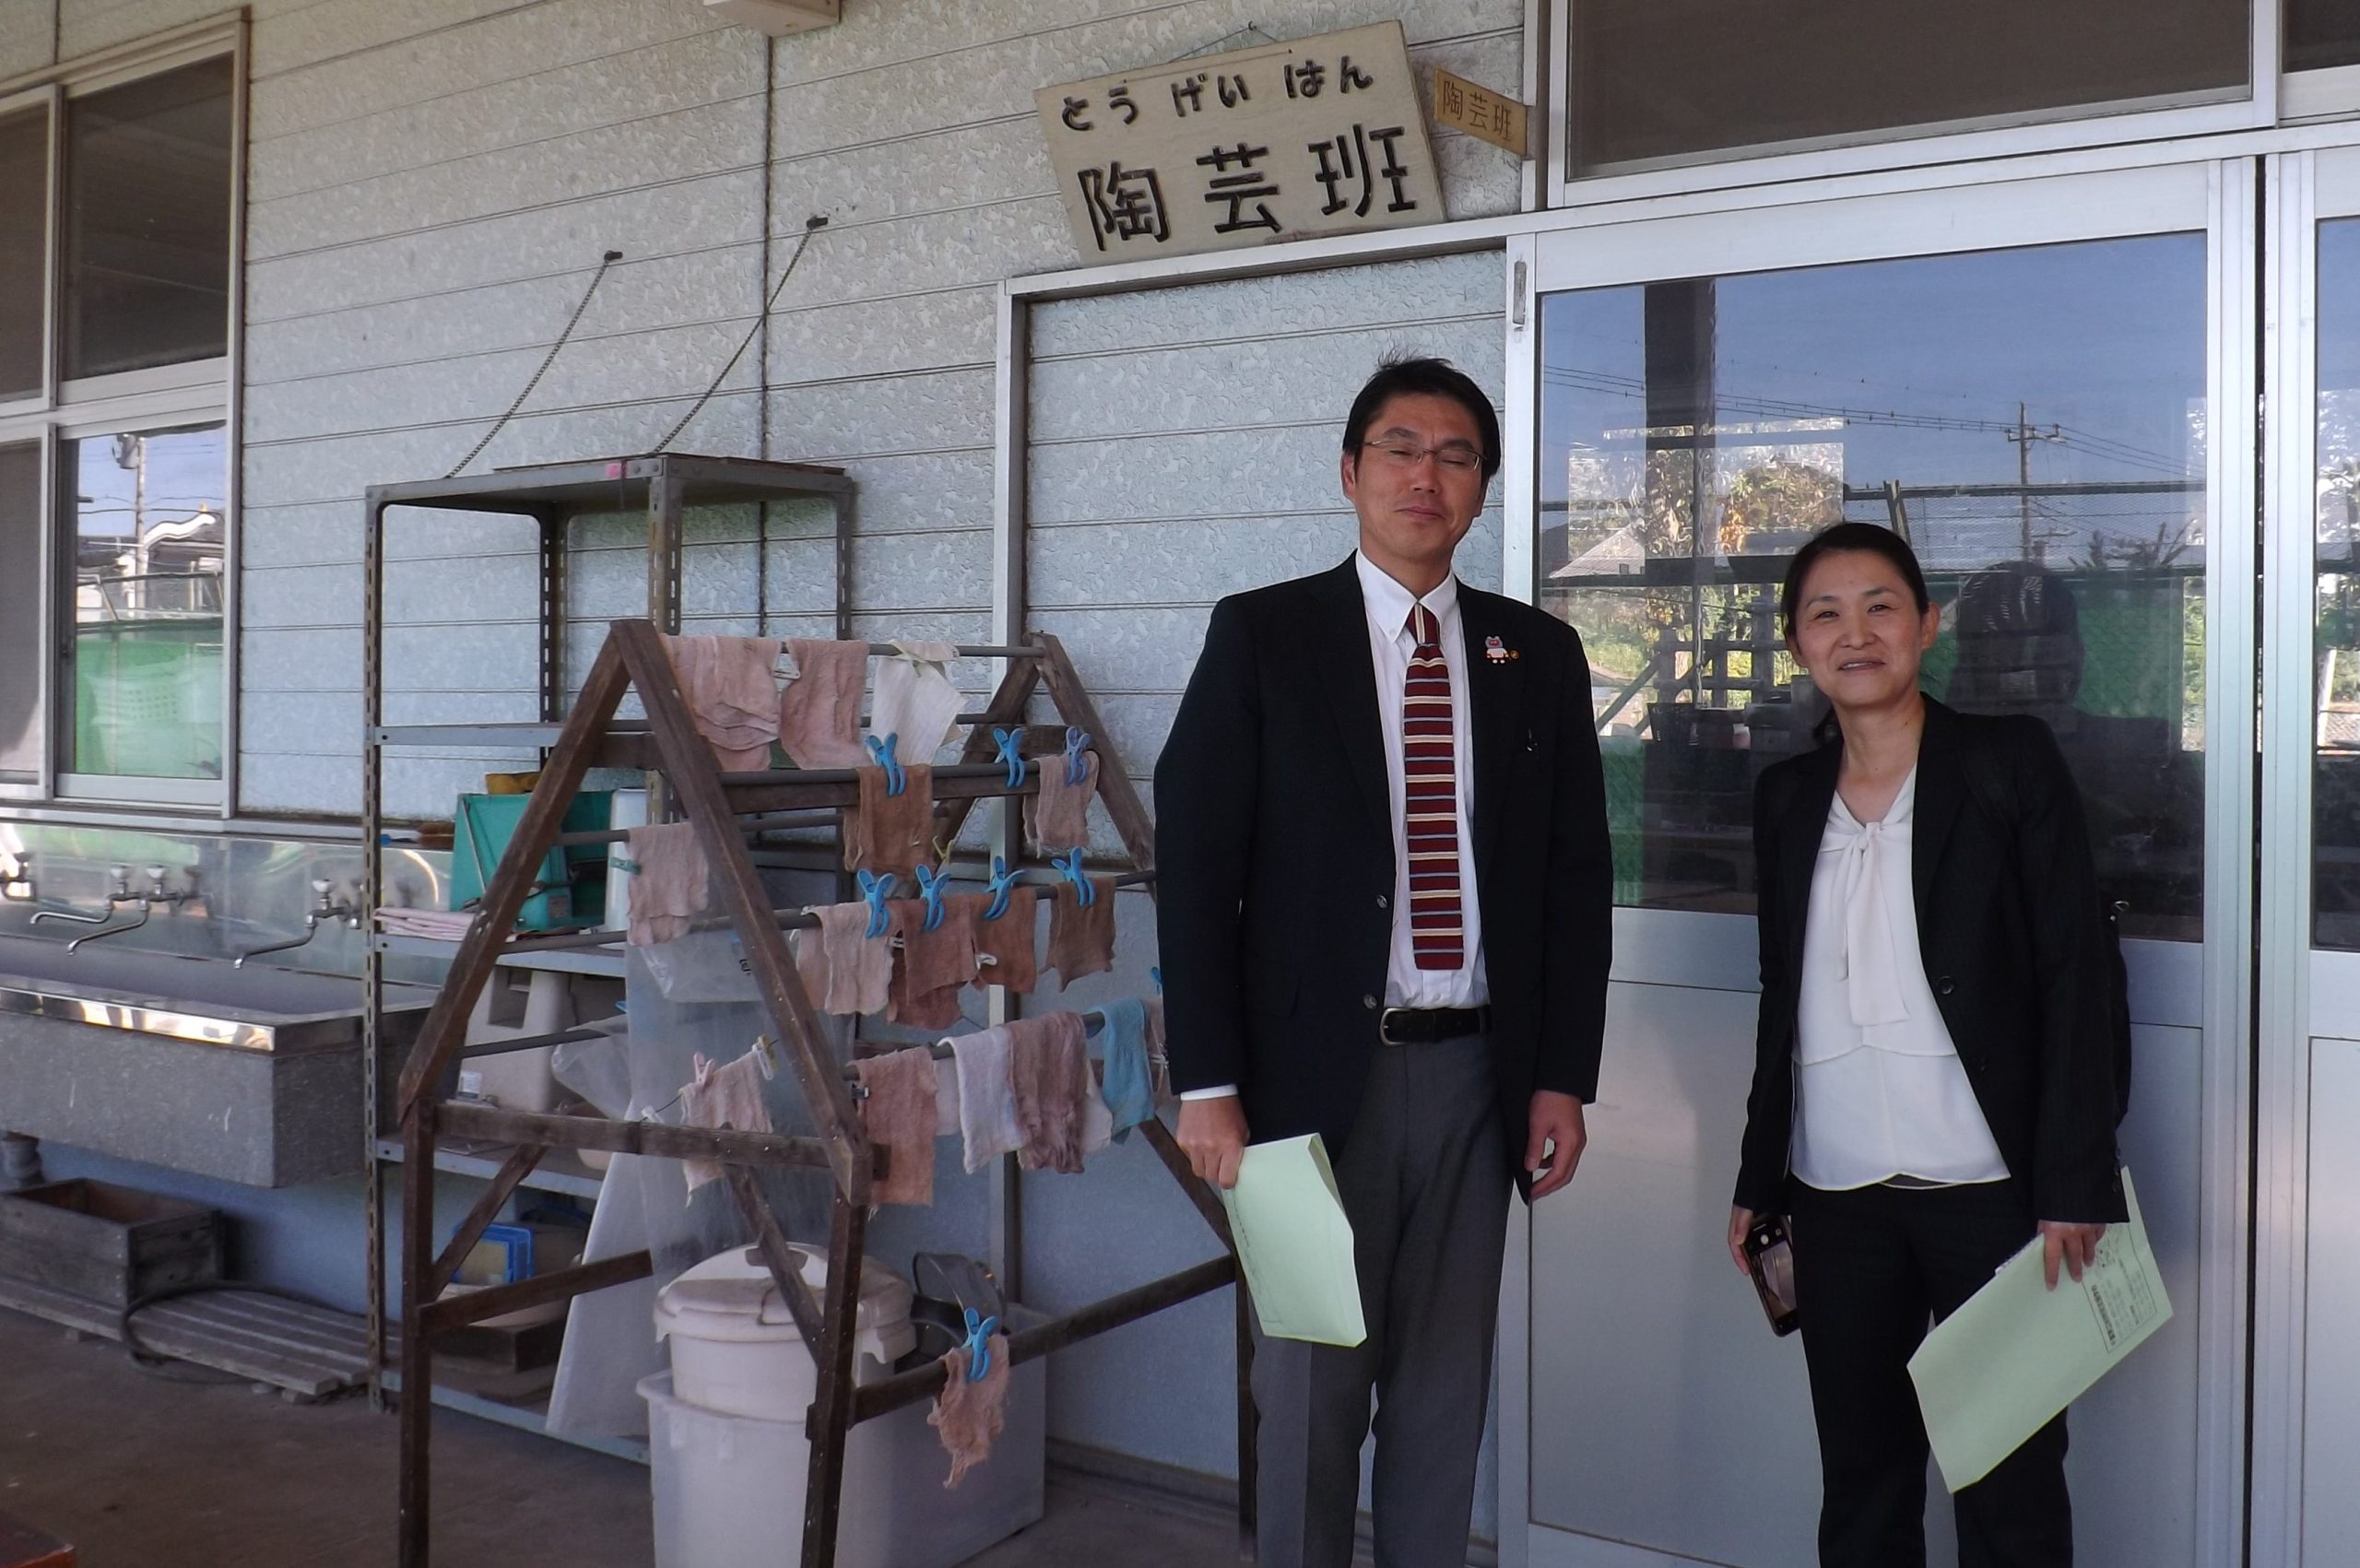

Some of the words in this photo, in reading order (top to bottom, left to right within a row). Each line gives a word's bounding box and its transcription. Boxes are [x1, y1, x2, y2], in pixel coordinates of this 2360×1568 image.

[1443, 80, 1512, 142] 陶芸班
[1078, 124, 1418, 252] 陶芸班
